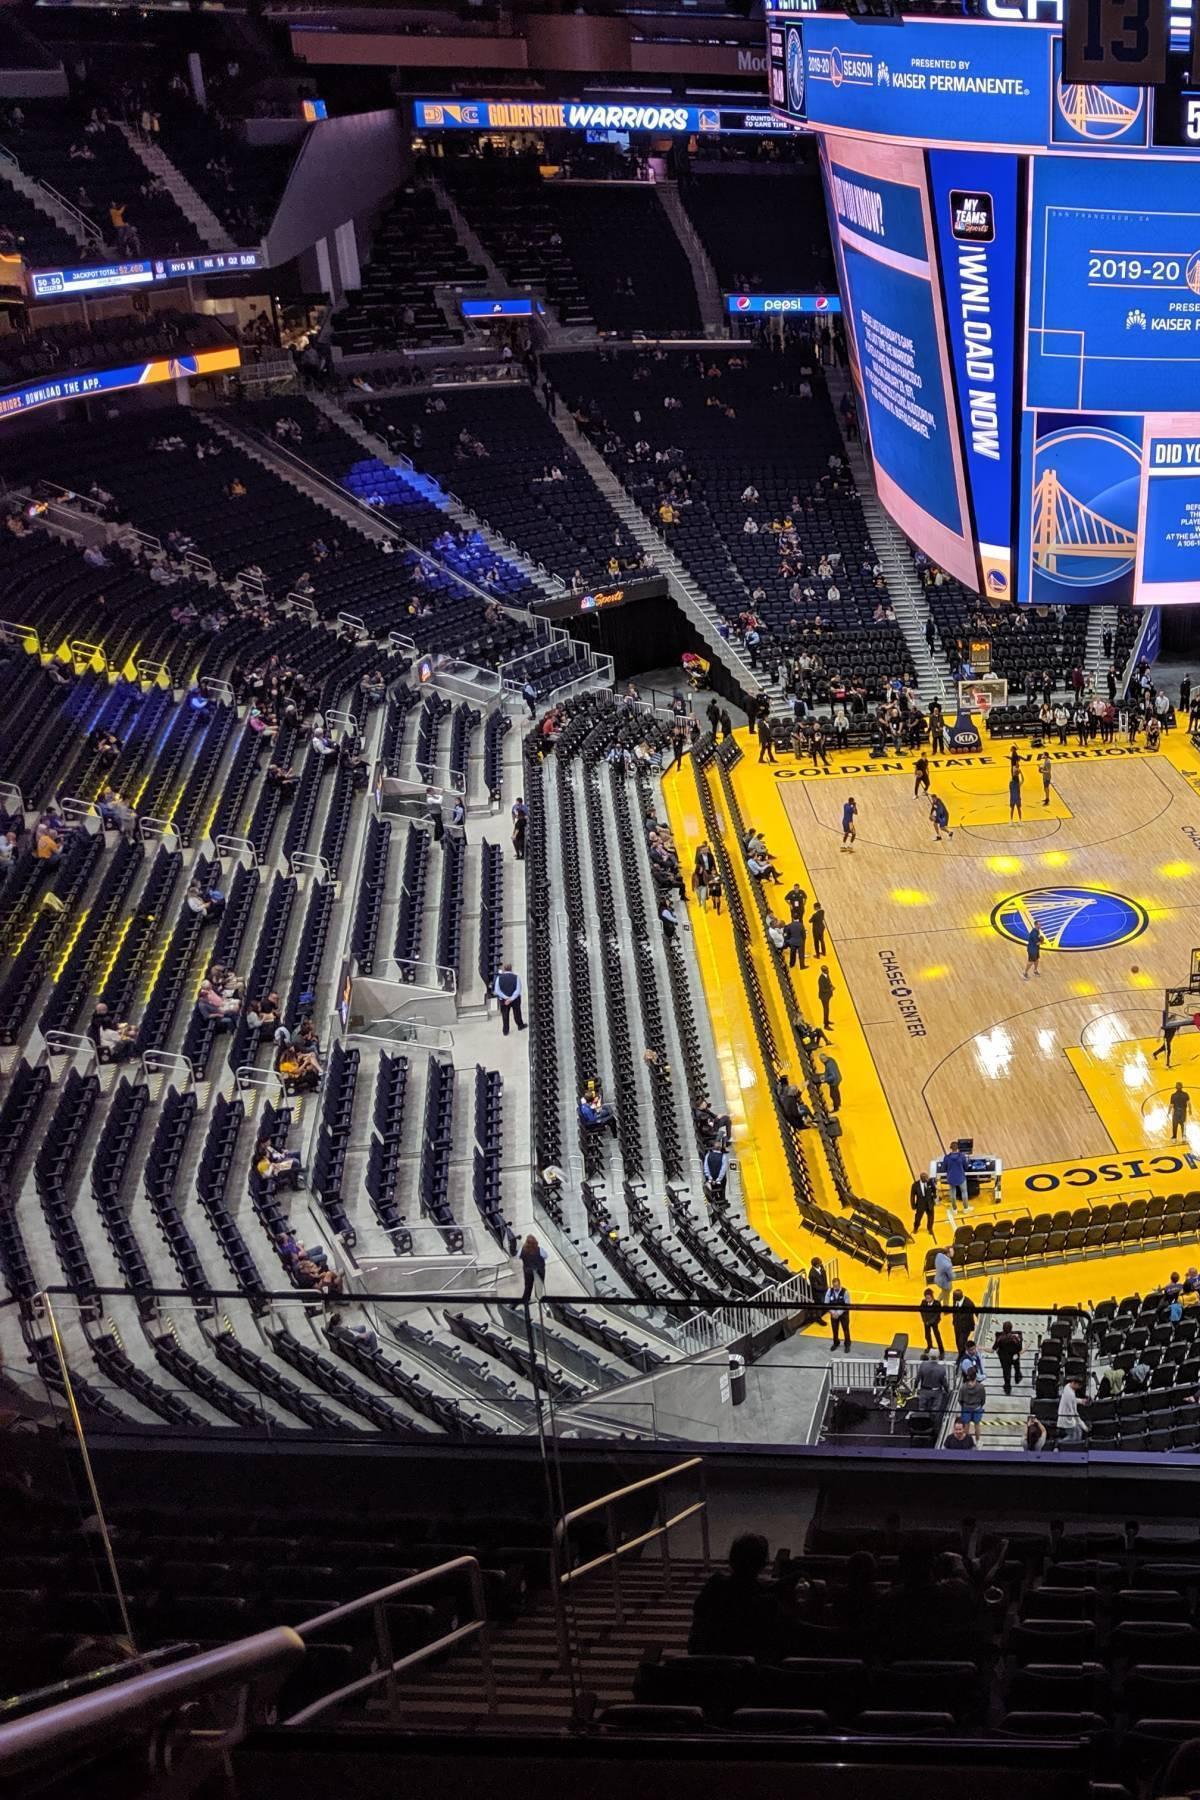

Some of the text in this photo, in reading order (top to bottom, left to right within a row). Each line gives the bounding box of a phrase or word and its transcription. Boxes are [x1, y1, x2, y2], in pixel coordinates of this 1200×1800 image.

[1082, 0, 1151, 63] 13
[808, 57, 873, 78] 2019-20 SEASON
[911, 58, 970, 70] PRESENTED BY
[893, 72, 926, 89] KAISER
[488, 104, 689, 130] GOLDEN STATE WARRIORS
[963, 198, 979, 211] MY
[956, 209, 987, 224] TEAMS
[171, 263, 186, 271] NYG
[187, 261, 195, 270] 14
[203, 258, 214, 268] NE
[217, 257, 224, 267] 14
[240, 255, 255, 265] 0:00
[1088, 259, 1180, 281] 2019-20
[72, 271, 99, 280] JACKPOT
[764, 298, 802, 312] pepsi
[1151, 318, 1191, 331] KAISER
[25, 385, 61, 405] DOWNLOAD
[64, 381, 80, 394] THE
[83, 378, 102, 389] APP.
[968, 388, 1001, 461] NOW
[1155, 443, 1182, 464] DID
[594, 591, 624, 607] Sports
[774, 762, 902, 780] GOLDEN
[878, 950, 927, 1038] CHASE CENTER
